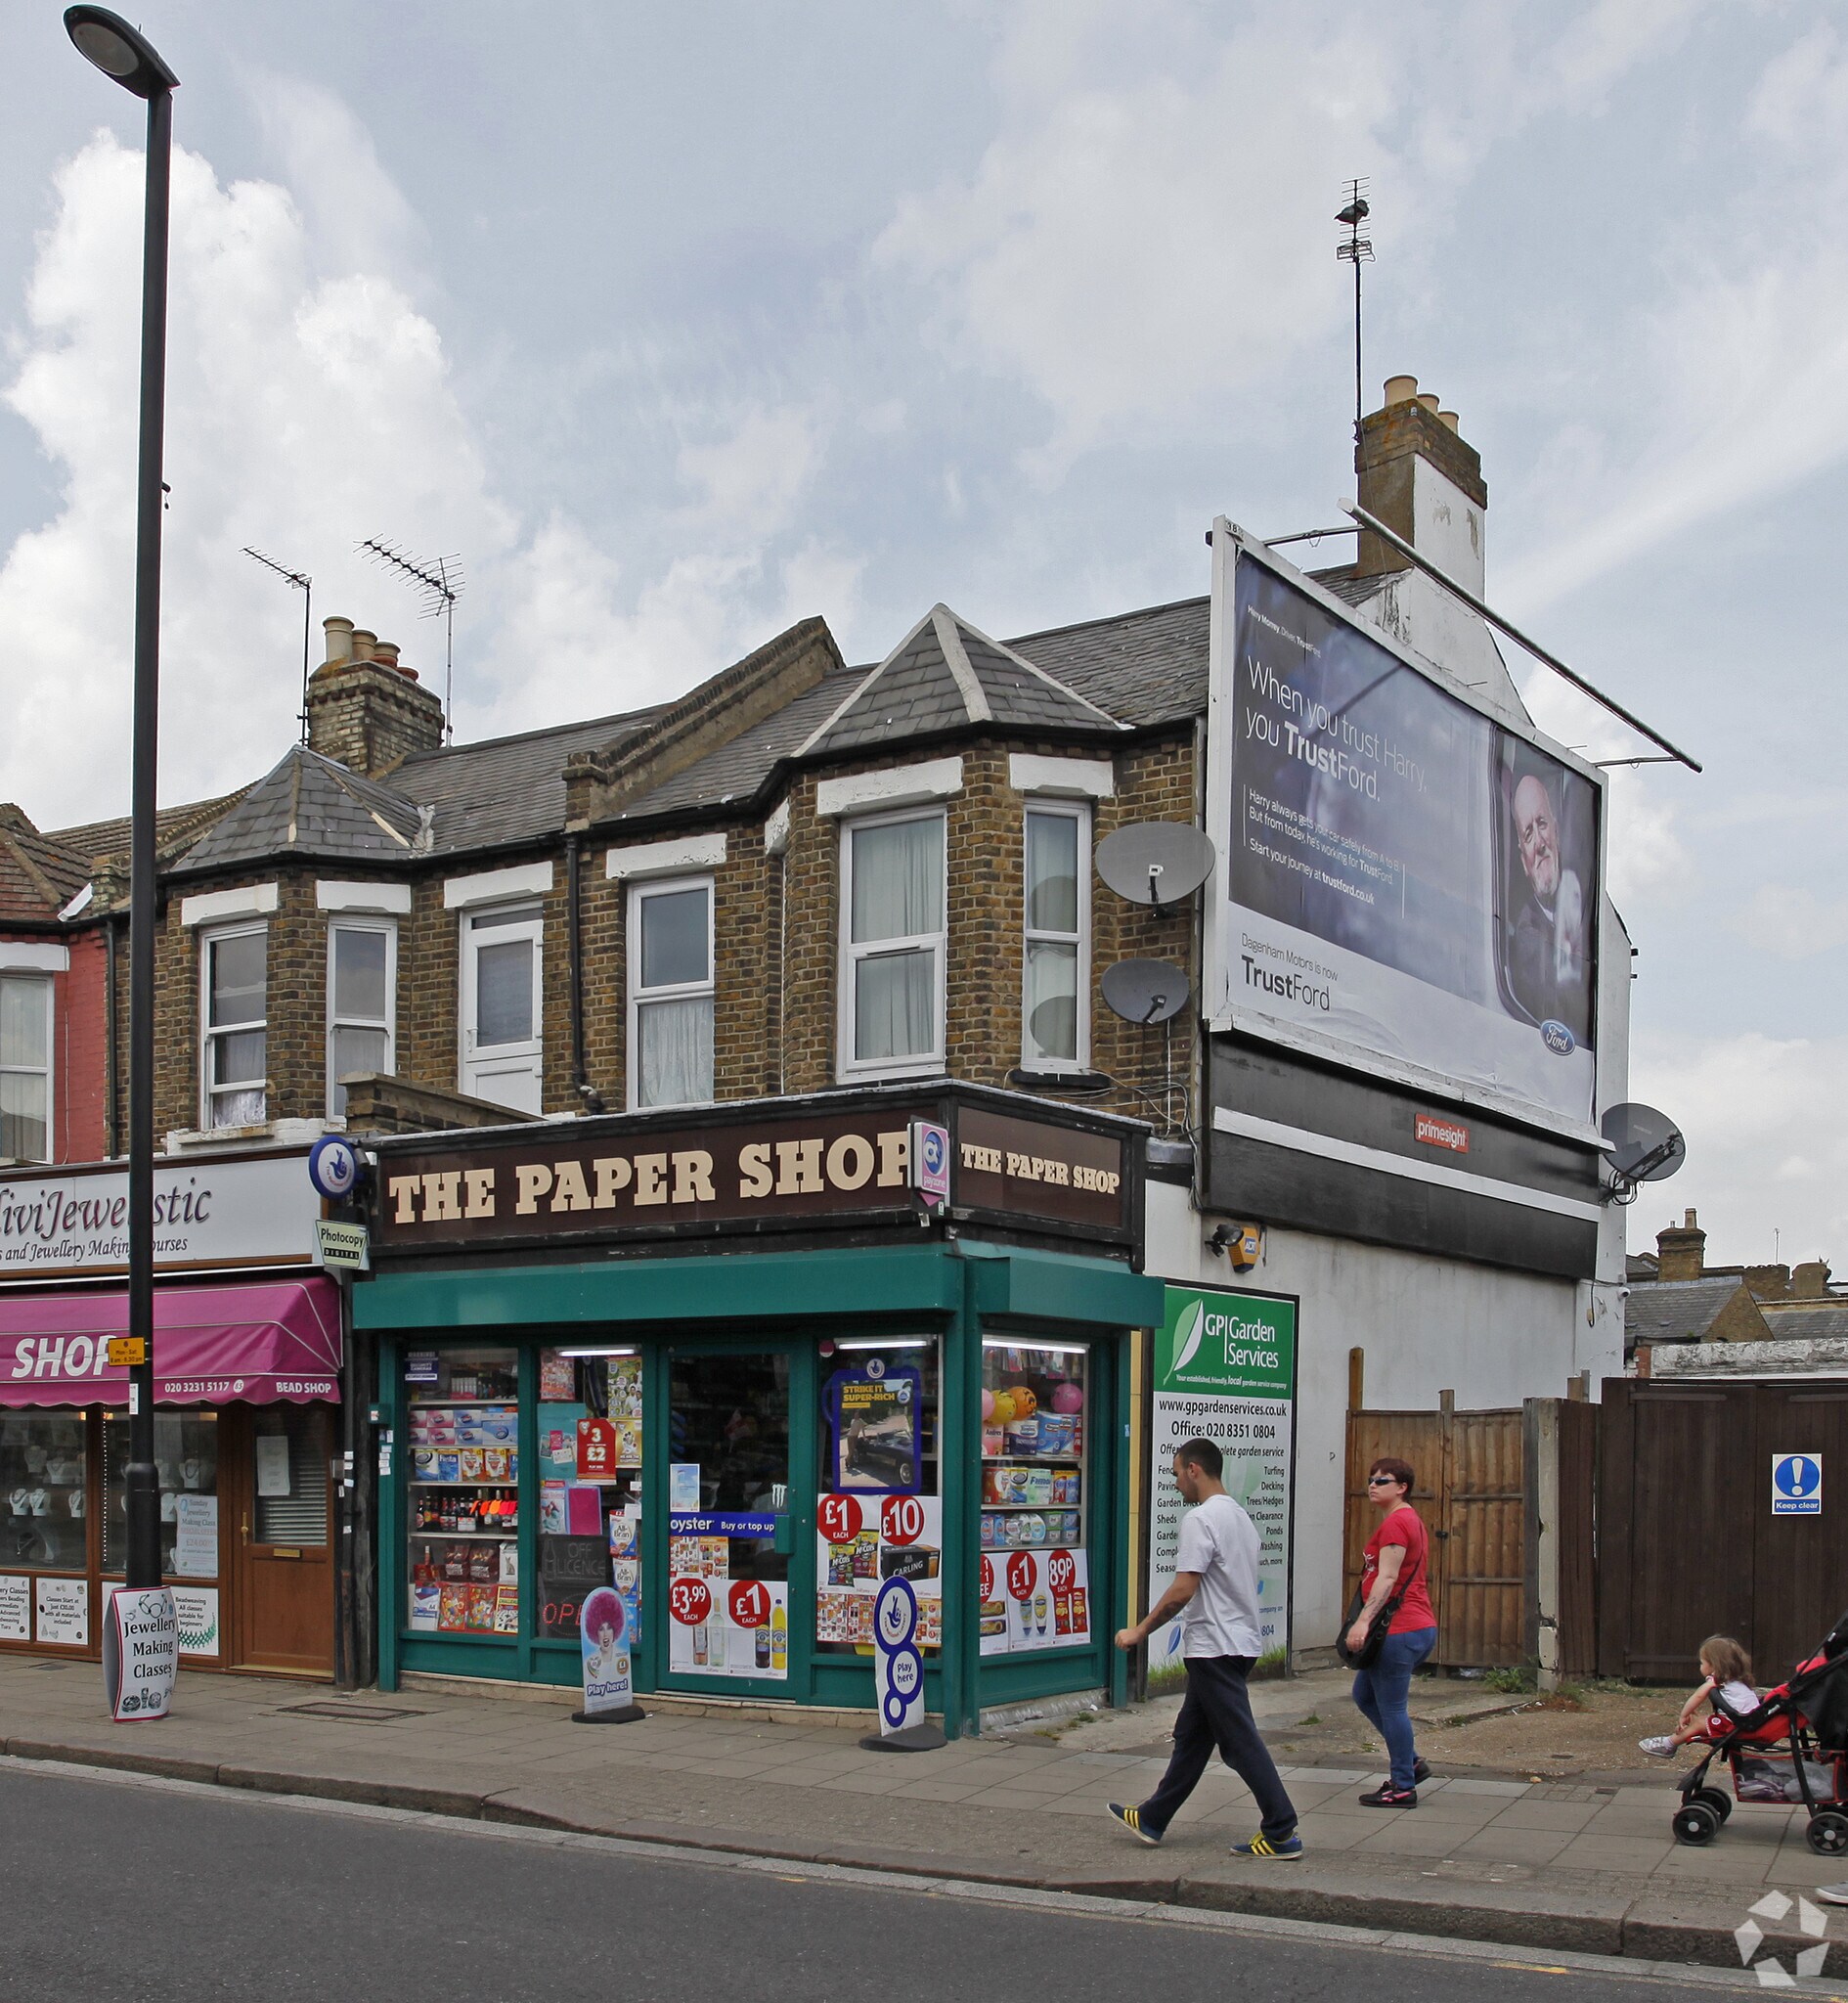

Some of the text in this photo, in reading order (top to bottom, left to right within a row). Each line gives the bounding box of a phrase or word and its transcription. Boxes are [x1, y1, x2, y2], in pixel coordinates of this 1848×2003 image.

[1248, 655, 1428, 793] When you trust Harry,
[1246, 707, 1381, 802] you TrustFord.
[1250, 787, 1270, 811] Harry
[1271, 800, 1298, 822] always
[1298, 813, 1313, 829] gets
[1313, 823, 1328, 837] your
[1329, 830, 1340, 842] car
[1341, 834, 1361, 855] safely
[1361, 844, 1378, 860] from
[1379, 854, 1385, 866] A
[1386, 857, 1393, 868] to
[1250, 806, 1263, 823] But
[1264, 813, 1283, 831] from
[1284, 823, 1306, 844] today,
[1306, 832, 1320, 850] he's
[1320, 843, 1347, 866] working
[1348, 854, 1358, 868] for
[1250, 838, 1375, 906] Start your journey at trustford.co.uk
[1242, 932, 1339, 981] Dagenham Motors is now
[1241, 955, 1330, 1011] TrustFord
[1546, 1024, 1568, 1051] Ford
[1418, 1121, 1467, 1148] primesight
[960, 1143, 1121, 1194] THE PAPER SHOP
[389, 1131, 908, 1224] THE PAPER SHOP
[923, 1176, 946, 1188] payzone
[321, 1227, 364, 1248] Photocopy
[5, 1244, 27, 1261] and
[29, 1238, 85, 1263] Jewellery
[88, 1237, 129, 1259] Makin
[153, 1237, 188, 1253] ourses
[325, 1249, 359, 1260] DIGITAL
[1205, 1313, 1275, 1342] GP Garden
[11, 1335, 117, 1378] SHOP
[1229, 1343, 1279, 1368] Services
[164, 1382, 182, 1394] 020
[183, 1382, 205, 1393] 3231
[207, 1381, 230, 1392] 5117
[276, 1381, 331, 1394] BEAD SHOP
[1228, 1375, 1242, 1386] local
[843, 1385, 873, 1394] STRIKE
[843, 1393, 896, 1402] SUPER-RICH
[1159, 1400, 1287, 1417] www.gpgardenservices.co.uk
[592, 1428, 601, 1443] 3
[1171, 1421, 1275, 1439] Office: 020 8351 0804
[587, 1447, 606, 1461] £2
[1238, 1445, 1261, 1458] garden
[1262, 1447, 1284, 1457] service
[1159, 1465, 1173, 1475] Fenc
[1264, 1466, 1285, 1477] Turfing
[1260, 1482, 1284, 1492] Decking
[1157, 1498, 1181, 1507] Garden
[825, 1499, 849, 1532] £1
[882, 1499, 920, 1536] £10
[1157, 1514, 1177, 1524] Sheds
[671, 1517, 712, 1533] oyster
[721, 1522, 736, 1532] Buy
[749, 1522, 762, 1532] top
[764, 1524, 774, 1534] up
[1265, 1527, 1283, 1536] Ponds
[1157, 1531, 1178, 1540] Garde
[568, 1542, 592, 1558] OFF
[1156, 1547, 1178, 1558] Compl
[555, 1560, 606, 1575] LICENCE
[894, 1561, 923, 1576] CARLING
[1012, 1556, 1030, 1588] £1
[1156, 1563, 1176, 1573] Seaso
[980, 1583, 990, 1596] EE
[673, 1585, 706, 1614] £3.99
[736, 1584, 761, 1616] £1
[124, 1618, 176, 1637] Jewellery
[1261, 1625, 1274, 1636] 804
[133, 1639, 173, 1657] Making
[134, 1662, 172, 1678] Classes
[898, 1663, 912, 1673] Play
[898, 1673, 913, 1683] here
[588, 1678, 629, 1697] Play here!
